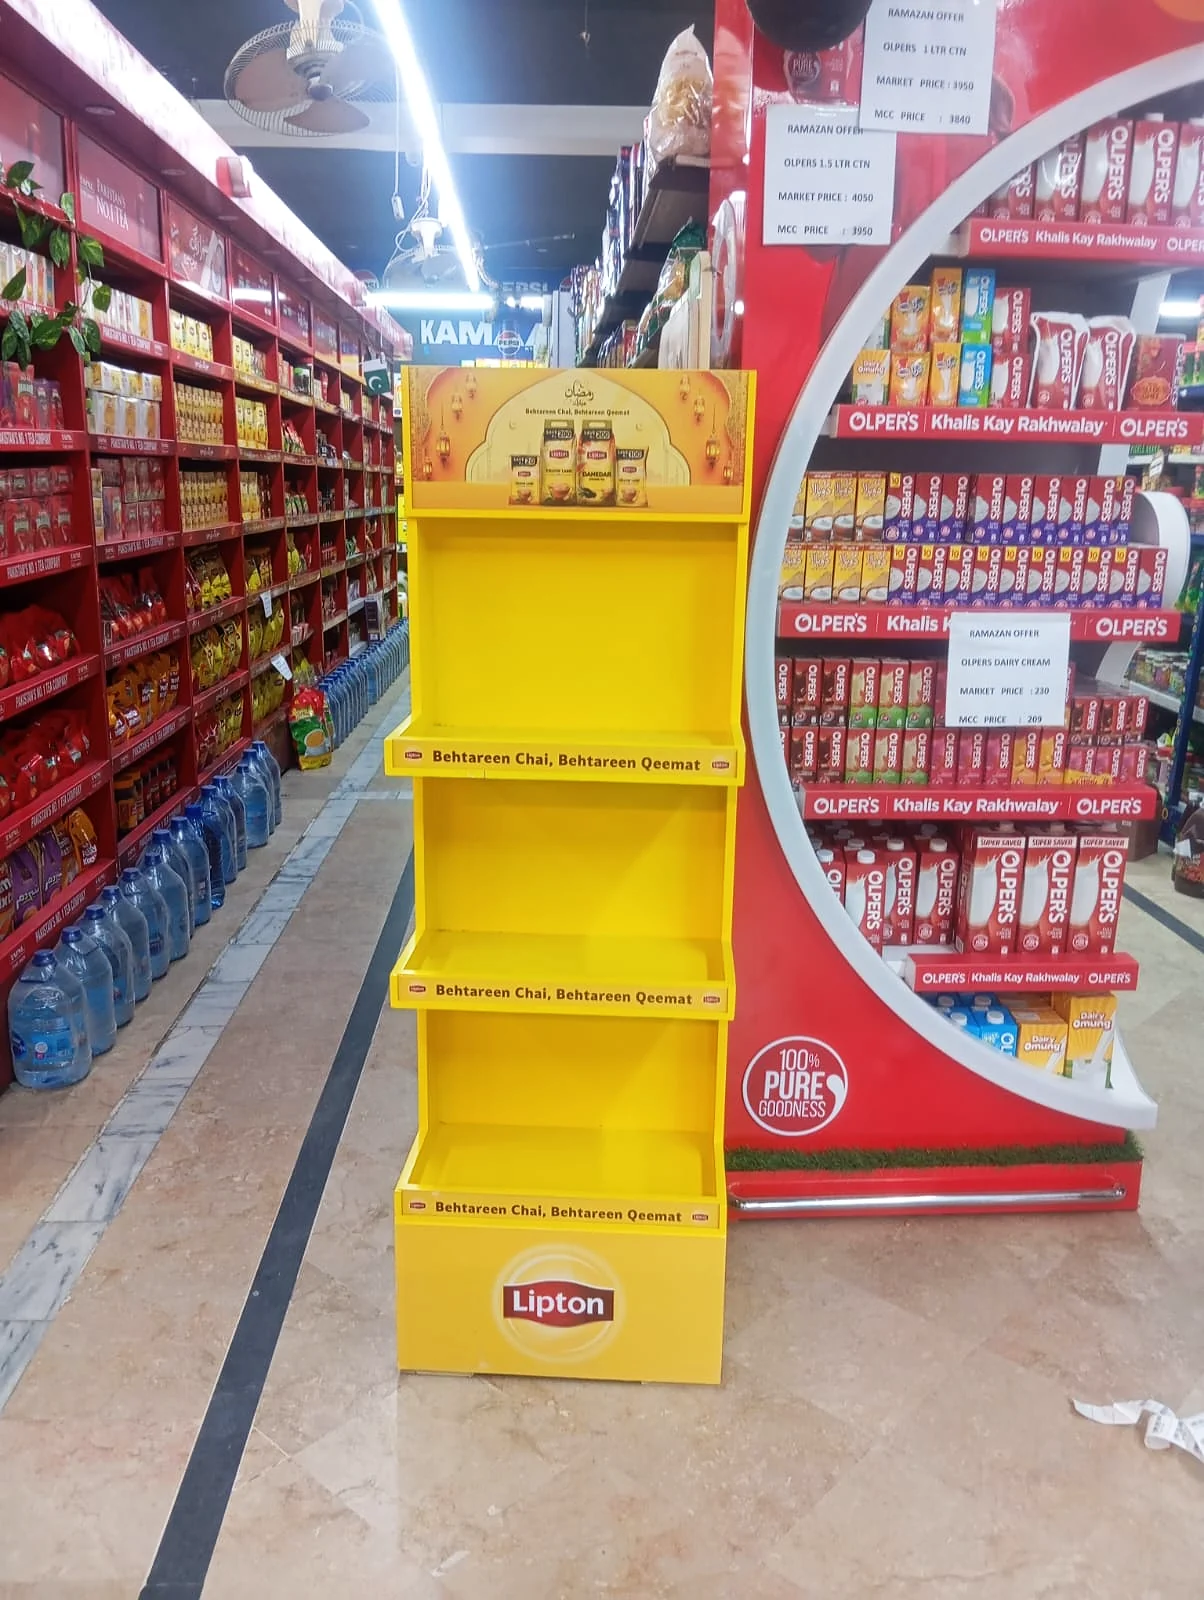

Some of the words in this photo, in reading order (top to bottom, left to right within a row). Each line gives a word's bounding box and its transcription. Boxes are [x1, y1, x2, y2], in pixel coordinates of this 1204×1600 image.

[888, 8, 934, 20] RAMAZAN
[936, 11, 964, 22] OFFER
[883, 42, 916, 53] OLPERS
[924, 45, 928, 54] 1
[930, 45, 946, 55] LTR
[949, 46, 967, 56] CTN
[876, 75, 914, 87] MARKET
[920, 79, 944, 89] PRICE
[953, 81, 974, 91] 3950
[874, 109, 894, 119] MCC
[901, 111, 926, 121] PRICE
[950, 114, 971, 124] 3840
[787, 124, 833, 135] RAMAZAN
[784, 158, 817, 168] OLPERS
[820, 159, 833, 169] 1.5
[835, 159, 850, 168] LTR
[852, 160, 870, 169] CTN
[1108, 126, 1128, 200] OLPER'S
[1153, 129, 1175, 203] OLPER'S
[778, 192, 815, 201] MARKET
[817, 193, 841, 202] PRICE
[852, 194, 874, 202] 4050
[777, 225, 797, 234] MCC
[804, 225, 829, 235] PRICE
[852, 227, 873, 236] 3950
[980, 227, 1029, 242] OLPER'S
[1036, 231, 1070, 243] Khalis
[1073, 232, 1094, 246] Kay
[1097, 233, 1158, 249] Rakhwalay
[1060, 329, 1073, 384] OLPER'S
[1104, 332, 1118, 385] OLPER'S
[606, 409, 630, 417] Qeemat
[849, 411, 919, 431] OLPER'S
[931, 414, 979, 430] Khalis
[983, 416, 1014, 434] Kay
[1018, 415, 1104, 436] Rakhwalay
[1120, 418, 1188, 437] OLPER'S
[902, 475, 913, 518] OLPER'S
[928, 476, 941, 519] OLPER'S
[956, 476, 969, 519] OLPER'S
[991, 477, 1003, 521] OLPER'S
[1019, 478, 1032, 521] OLPER'S
[1047, 478, 1060, 521] OLPER'S
[1074, 479, 1087, 521] OLPER'S
[1102, 479, 1115, 522] OLPER'S
[904, 548, 917, 589] OLPER'S
[932, 548, 945, 590] OLPER'S
[959, 548, 973, 591] OLPER'S
[988, 548, 1001, 591] OLPER'S
[1015, 549, 1029, 591] OLPER'S
[1043, 549, 1055, 591] OLPER'S
[1070, 549, 1083, 591] OLPER'S
[794, 612, 867, 632] OLPER'S
[887, 615, 938, 631] Khalis
[1096, 617, 1168, 636] OLPER'S
[969, 629, 1012, 638] RAMAZAN
[1014, 630, 1039, 638] OFFER
[961, 658, 992, 667] OLPERS
[994, 659, 1020, 667] DAIRY
[1021, 659, 1051, 667] CREAM
[960, 687, 995, 695] MARKET
[1001, 687, 1024, 695] PRICE
[432, 750, 510, 764] Behtareen
[516, 752, 554, 768] Chai,
[558, 754, 637, 769] Behtareen
[641, 757, 701, 773] Qeemat
[814, 797, 879, 814] OLPER'S
[893, 798, 939, 812] Khalis
[944, 799, 972, 815] Kay
[976, 797, 1058, 815] Rakhwalay
[1077, 797, 1142, 815] OLPER'S
[980, 839, 1000, 847] SUPER
[1032, 839, 1052, 847] SUPER
[1083, 839, 1103, 847] SUPER
[1104, 839, 1125, 847] SAVER
[897, 857, 913, 916] OLPER'S
[938, 858, 956, 916] OLPER'S
[997, 850, 1020, 924] OLPER'S
[1049, 850, 1072, 924] OLPER'S
[1099, 850, 1123, 924] OLPER'S
[867, 870, 883, 930] OLPER'S
[922, 971, 965, 984] OLPER'S
[972, 973, 1001, 983] Khalis
[1004, 974, 1023, 985] Kay
[1026, 972, 1080, 985] Rakhwalay
[1088, 972, 1131, 984] OLPER'S
[436, 984, 510, 998] Behtareen
[515, 987, 551, 1001] Chai,
[556, 988, 631, 1003] Behtareen
[636, 991, 692, 1006] Qeemat
[1072, 1019, 1112, 1030] Omung
[1079, 1012, 1105, 1022] Dairy
[1024, 1042, 1062, 1052] Omung
[1031, 1035, 1056, 1044] Dairy
[779, 1048, 820, 1071] 100%
[764, 1071, 826, 1100] PURE
[758, 1100, 827, 1118] GOODNESS
[435, 1201, 507, 1216] Behtareen
[511, 1204, 546, 1218] Chai,
[551, 1206, 622, 1220] Behtareen
[628, 1209, 682, 1224] Qeemat
[513, 1290, 604, 1317] Lipton
